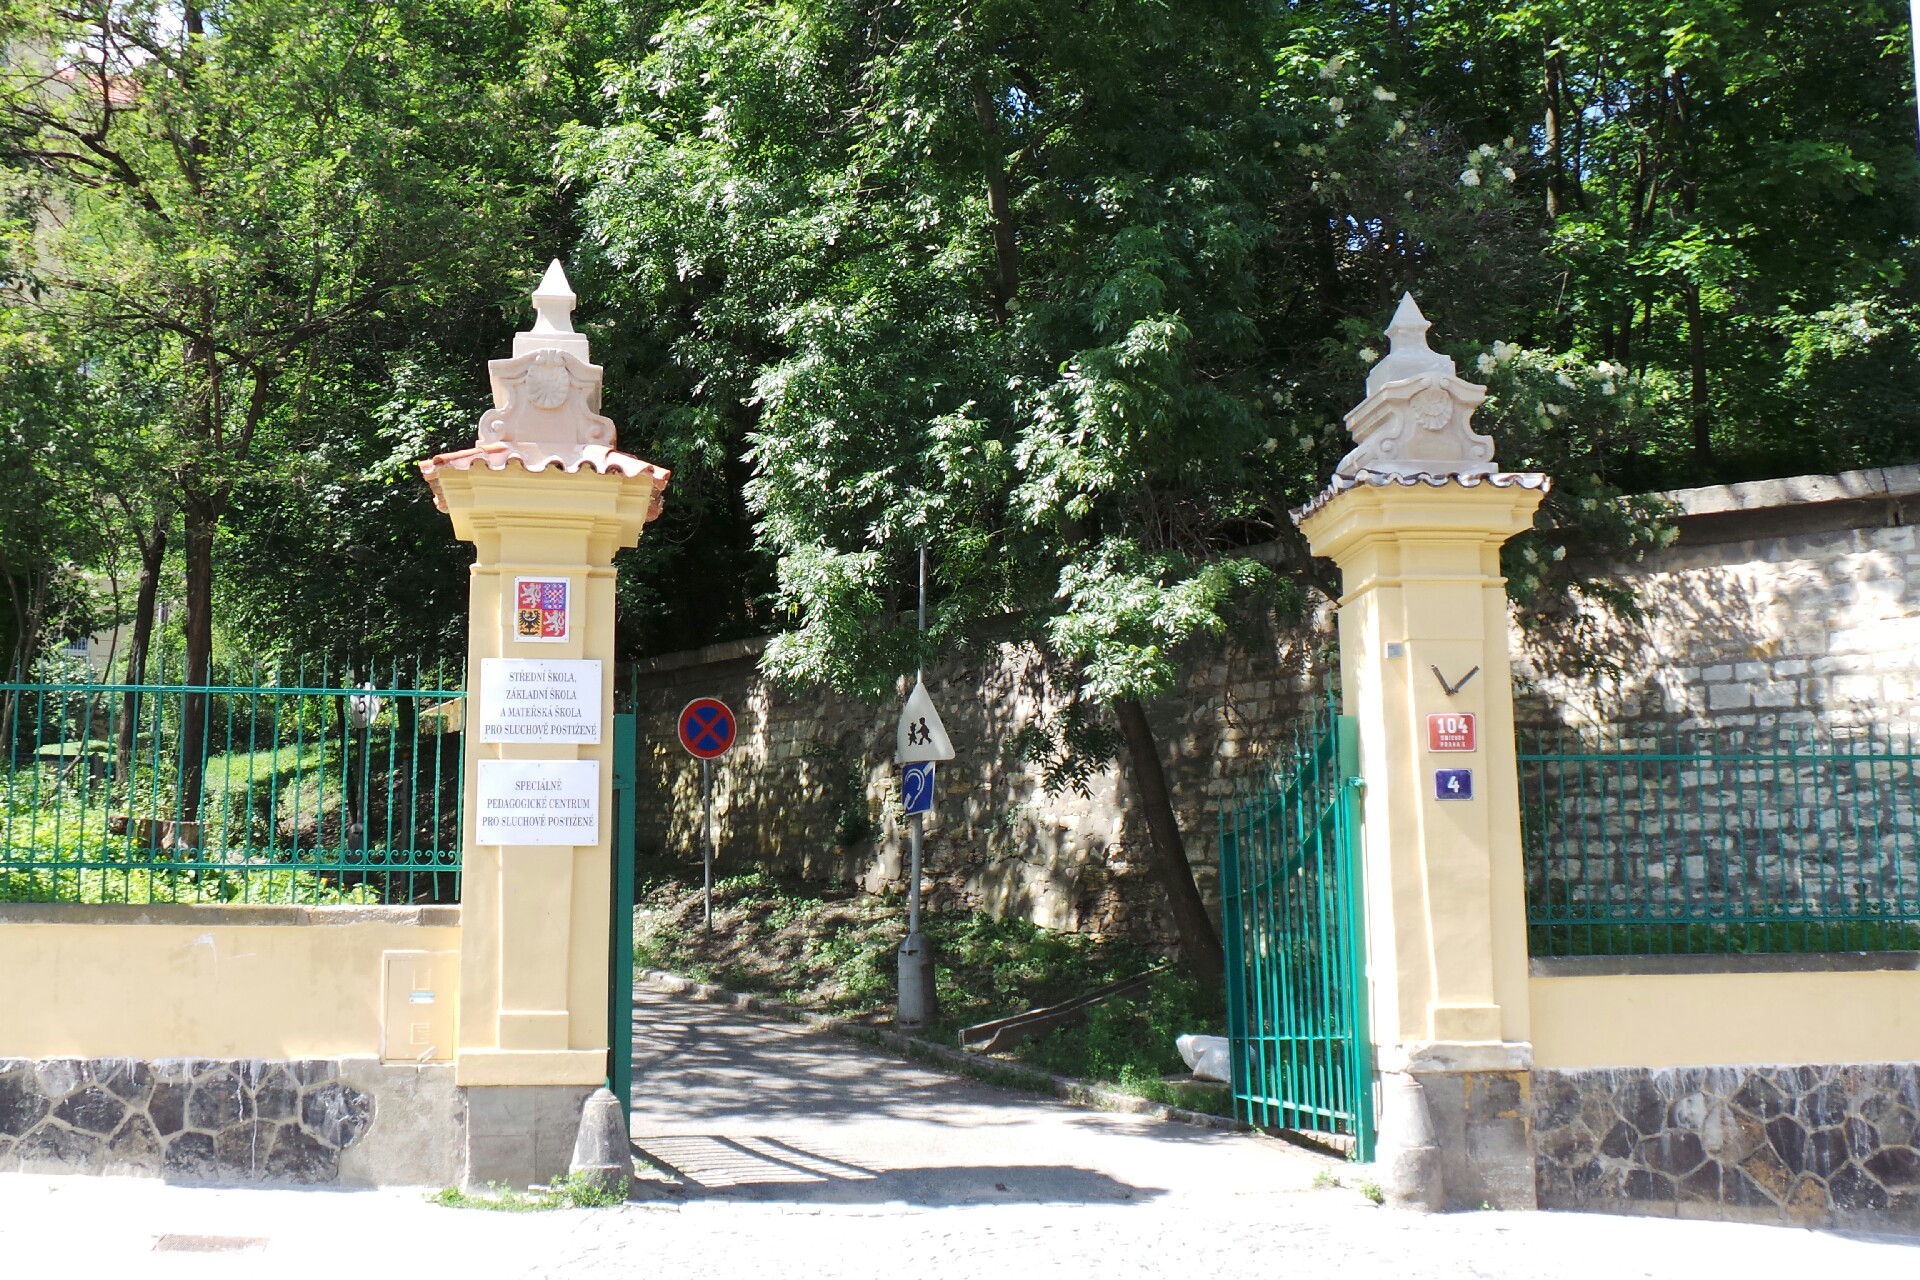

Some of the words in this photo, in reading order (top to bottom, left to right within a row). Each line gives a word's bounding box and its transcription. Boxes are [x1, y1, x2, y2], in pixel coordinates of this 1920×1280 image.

[509, 669, 545, 682] STŘEDNÍ
[548, 669, 577, 683] ŠKOLA,
[506, 686, 548, 700] ZÁKLADNÍ
[550, 687, 577, 700] ŠKOLA
[500, 707, 506, 717] A
[508, 704, 553, 718] MATEŘSKÁ
[555, 704, 582, 718] ŠKOLA
[485, 724, 503, 735] PRO
[505, 722, 549, 735] SLUCHOVĚ
[550, 722, 597, 736] POSTIŽENÉ
[1438, 717, 1469, 734] 104
[515, 777, 562, 791] SPECIÁLNĚ
[1447, 775, 1460, 793] 4
[487, 795, 547, 809] PEDAGOGICKÉ
[549, 798, 590, 809] CENTRUM
[482, 816, 499, 827] PRO
[501, 813, 546, 827] SLUCHOVĚ
[548, 813, 594, 827] POSTIŽENÉ
